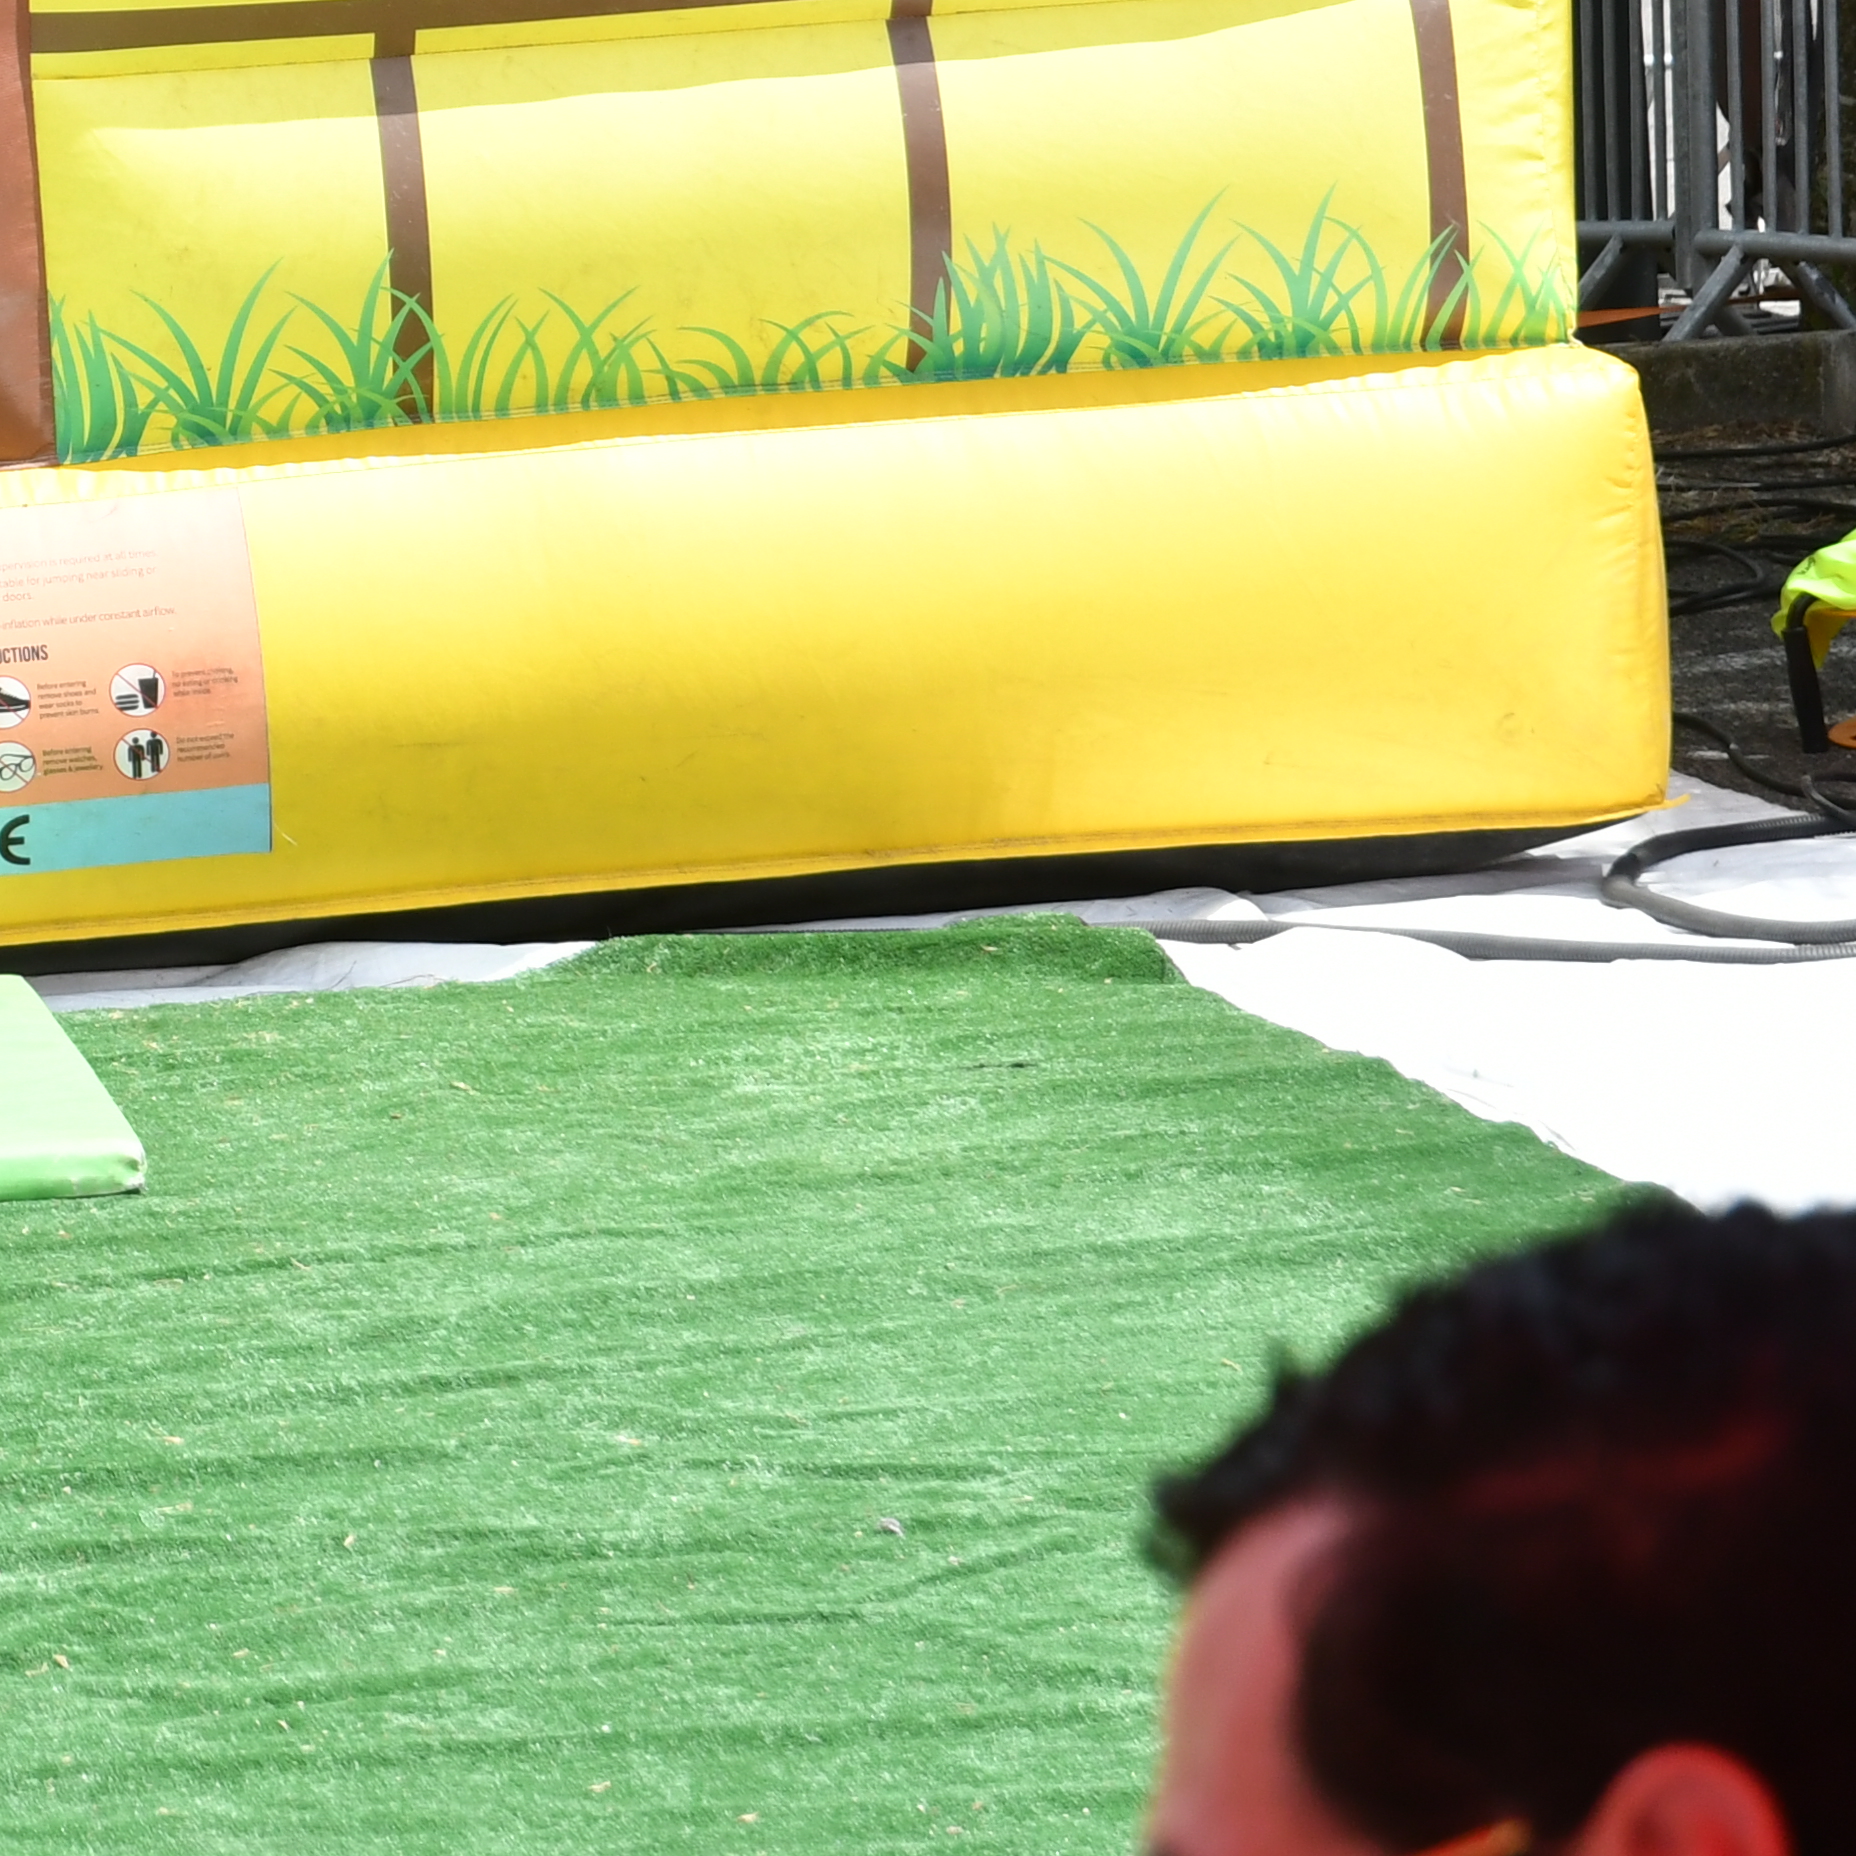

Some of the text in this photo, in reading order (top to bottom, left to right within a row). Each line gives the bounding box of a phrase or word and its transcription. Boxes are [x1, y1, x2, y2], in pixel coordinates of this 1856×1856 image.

[49, 558, 57, 567] is
[59, 554, 100, 567] required
[103, 552, 112, 561] at
[115, 551, 126, 560] all
[27, 575, 40, 586] for
[42, 573, 84, 587] jumping
[86, 570, 109, 580] near
[111, 567, 144, 577] sliding
[146, 565, 156, 575] or
[43, 615, 68, 626] while
[69, 613, 97, 624] under
[99, 609, 142, 621] constant
